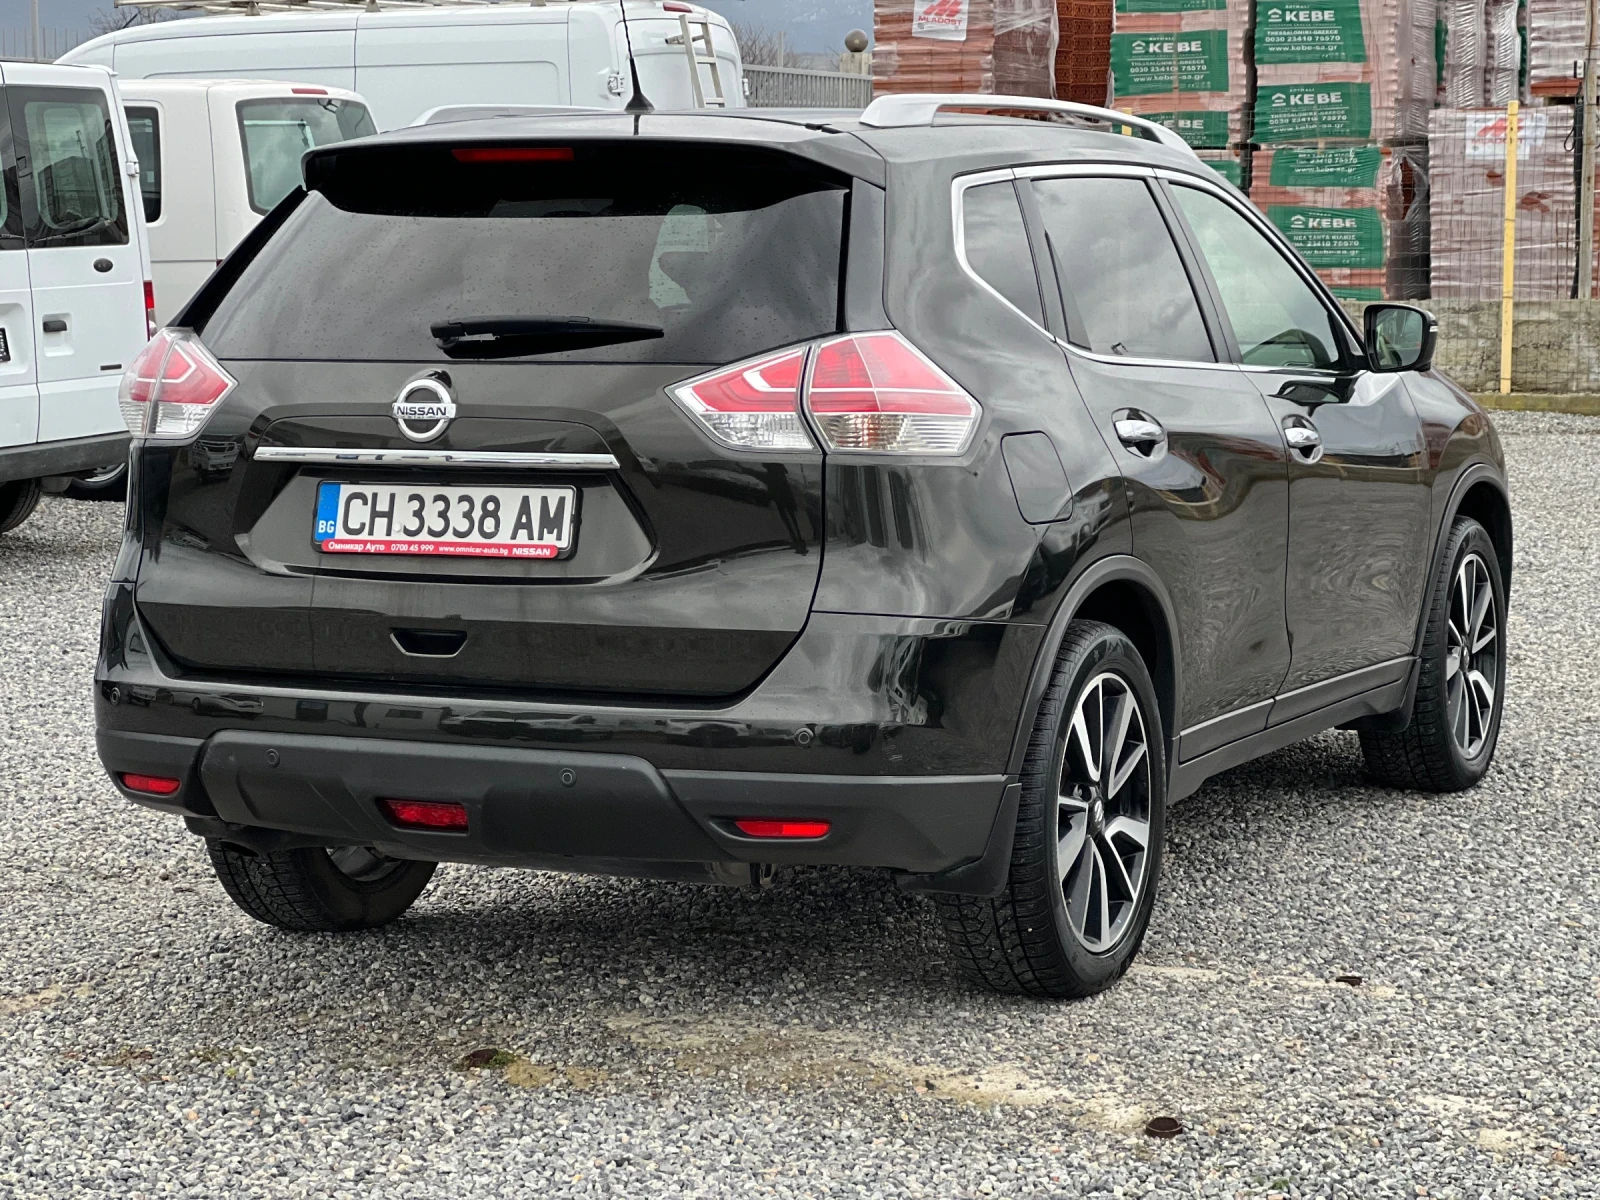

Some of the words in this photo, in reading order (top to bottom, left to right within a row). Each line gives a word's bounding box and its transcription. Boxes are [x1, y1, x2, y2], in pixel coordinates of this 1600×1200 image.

[917, 16, 962, 26] MLADOST
[1285, 10, 1335, 22] KEBE
[1149, 41, 1202, 53] KEBE
[1290, 92, 1342, 105] KEBE
[1308, 218, 1357, 228] KEBE
[396, 406, 447, 416] NISSAN
[342, 491, 396, 537] CH
[403, 493, 501, 539] 3338
[510, 495, 566, 541] AM
[318, 520, 335, 533] BG
[328, 541, 364, 552] Омникар
[365, 542, 385, 552] Ауто
[391, 543, 408, 552] 0700
[409, 544, 419, 552] 45
[420, 544, 434, 552] 999
[439, 546, 508, 555] www.omnicar-auto.bg
[512, 547, 550, 556] NISSAN
